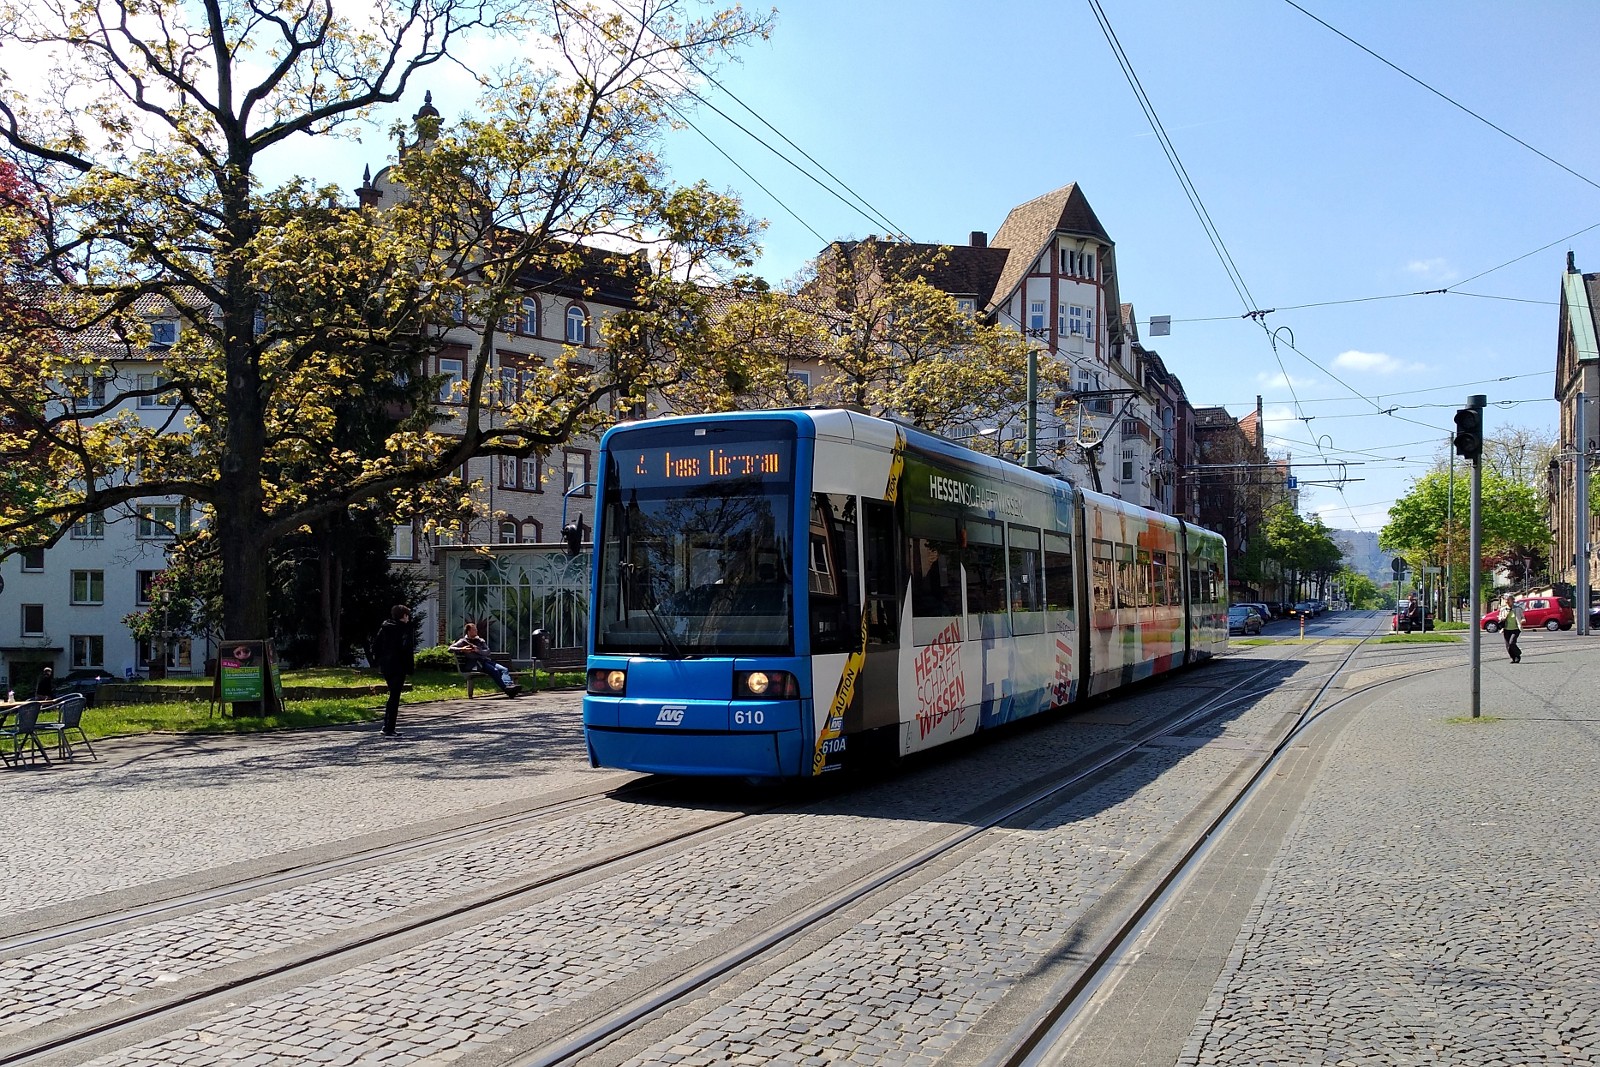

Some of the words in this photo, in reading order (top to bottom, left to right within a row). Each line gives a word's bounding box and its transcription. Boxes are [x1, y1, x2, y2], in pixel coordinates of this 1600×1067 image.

[914, 618, 961, 686] HESSEN
[917, 645, 962, 713] SCHAFFT
[734, 710, 764, 725] 610
[833, 668, 855, 716] AUTION
[919, 671, 966, 741] WISSEN
[822, 738, 846, 754] 610A
